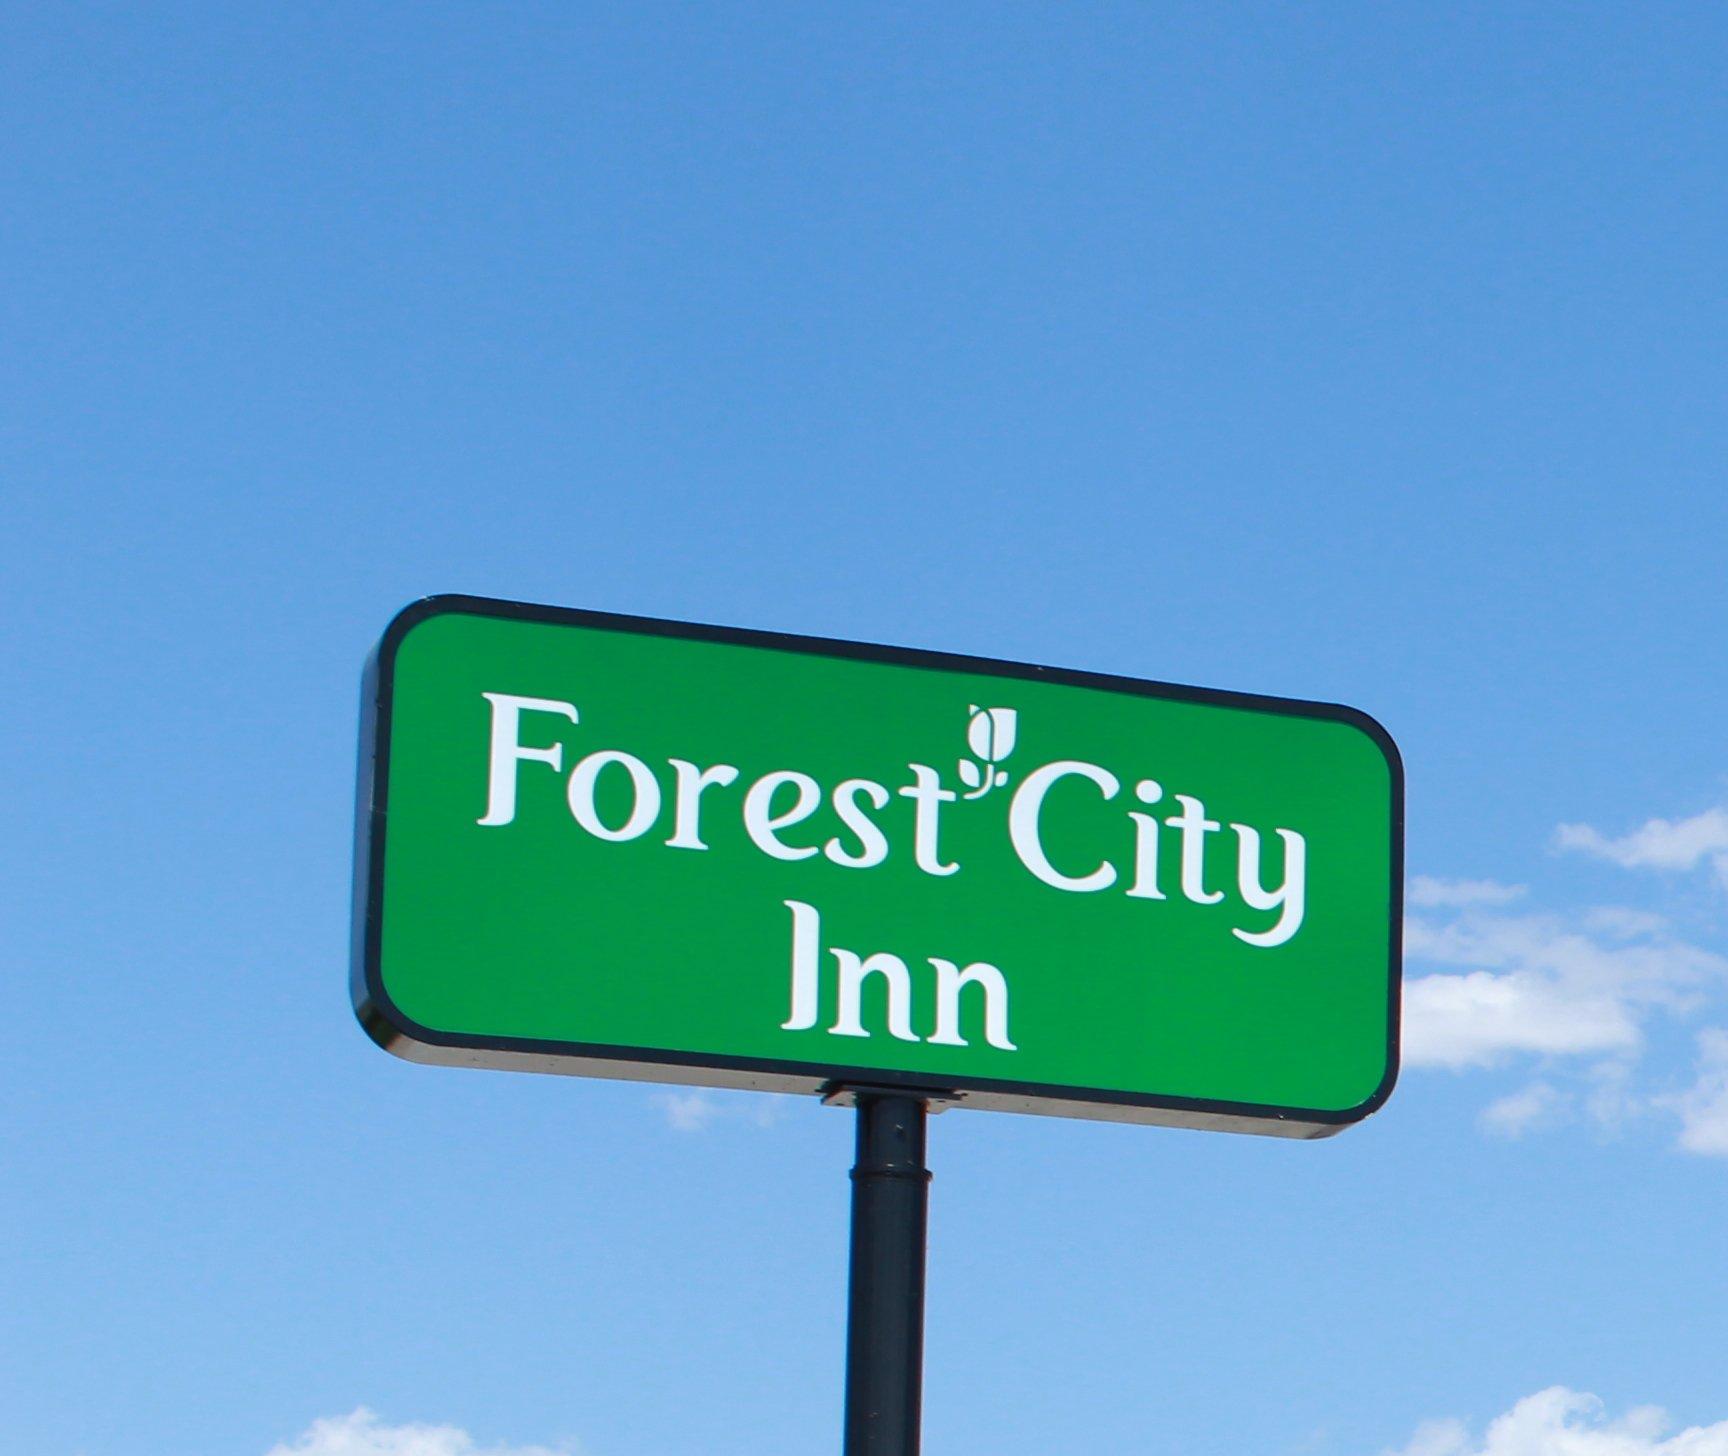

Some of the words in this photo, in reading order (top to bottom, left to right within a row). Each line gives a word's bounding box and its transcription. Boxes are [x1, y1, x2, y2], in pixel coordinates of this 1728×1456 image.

[476, 692, 959, 876] Forest
[1008, 760, 1305, 947] City
[780, 900, 1017, 1051] Inn
